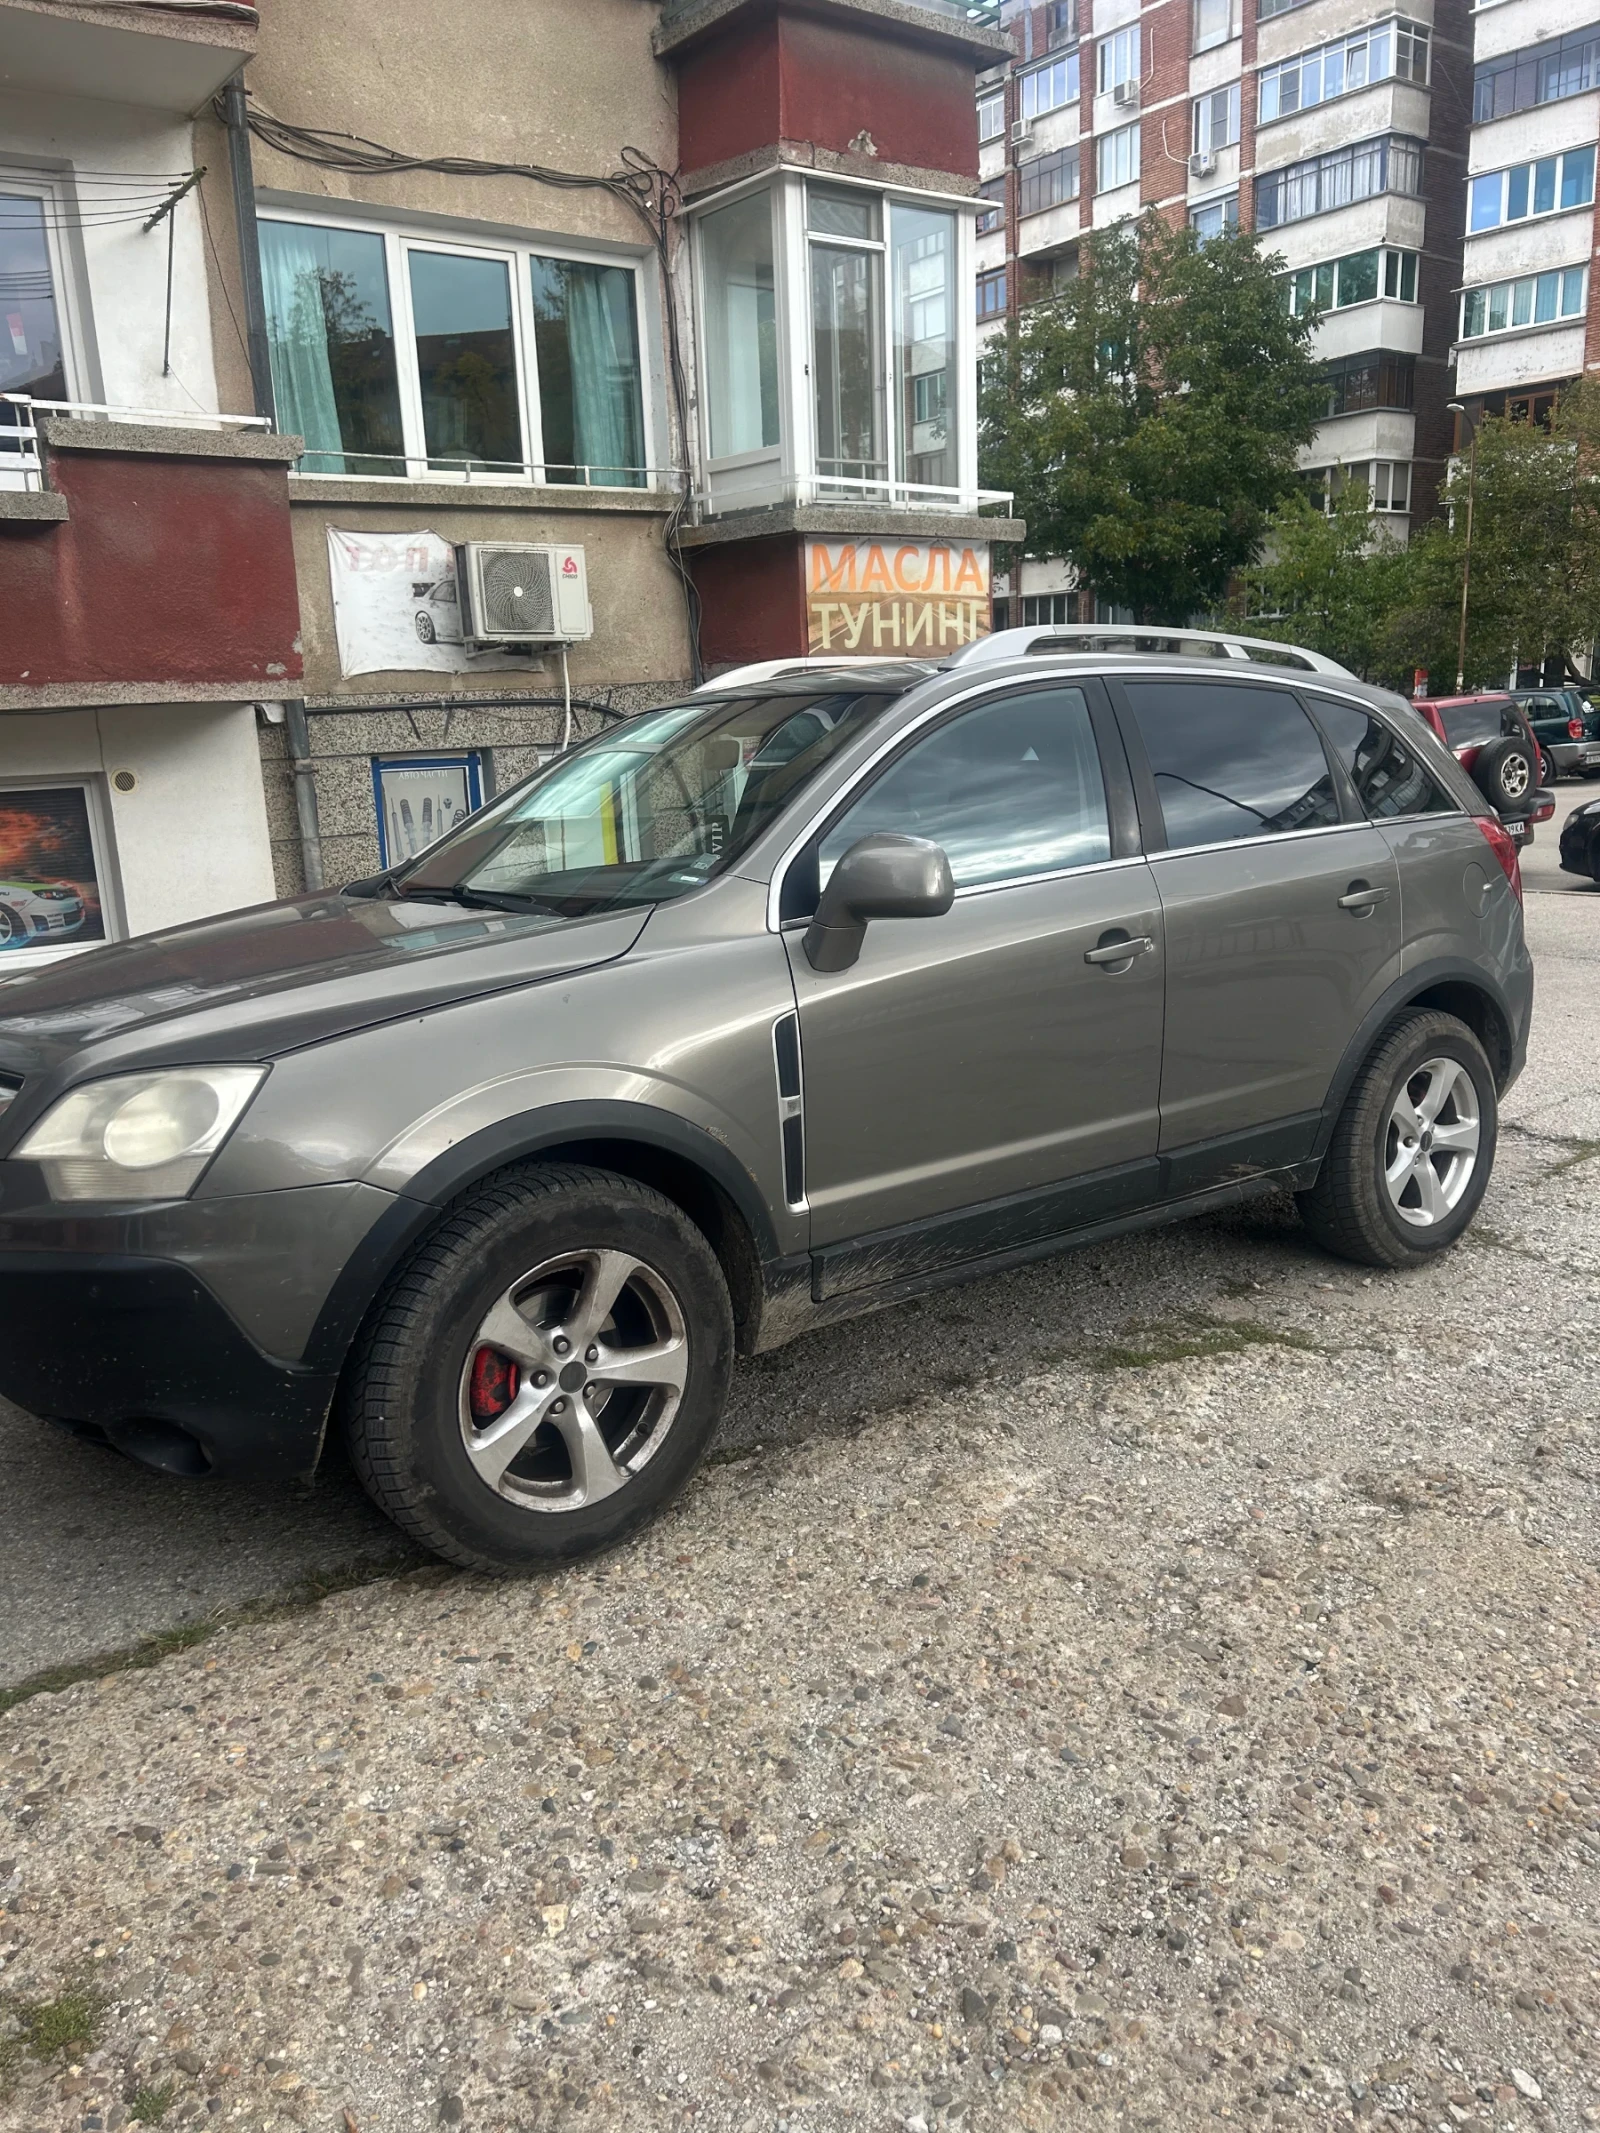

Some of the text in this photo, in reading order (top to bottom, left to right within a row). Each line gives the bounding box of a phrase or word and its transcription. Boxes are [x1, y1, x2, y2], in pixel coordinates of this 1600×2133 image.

[812, 543, 984, 592] МАСЛА
[811, 601, 988, 649] ТУНИНГ
[398, 769, 448, 780] АВТО ЧАСТИ
[712, 822, 723, 853] VIP
